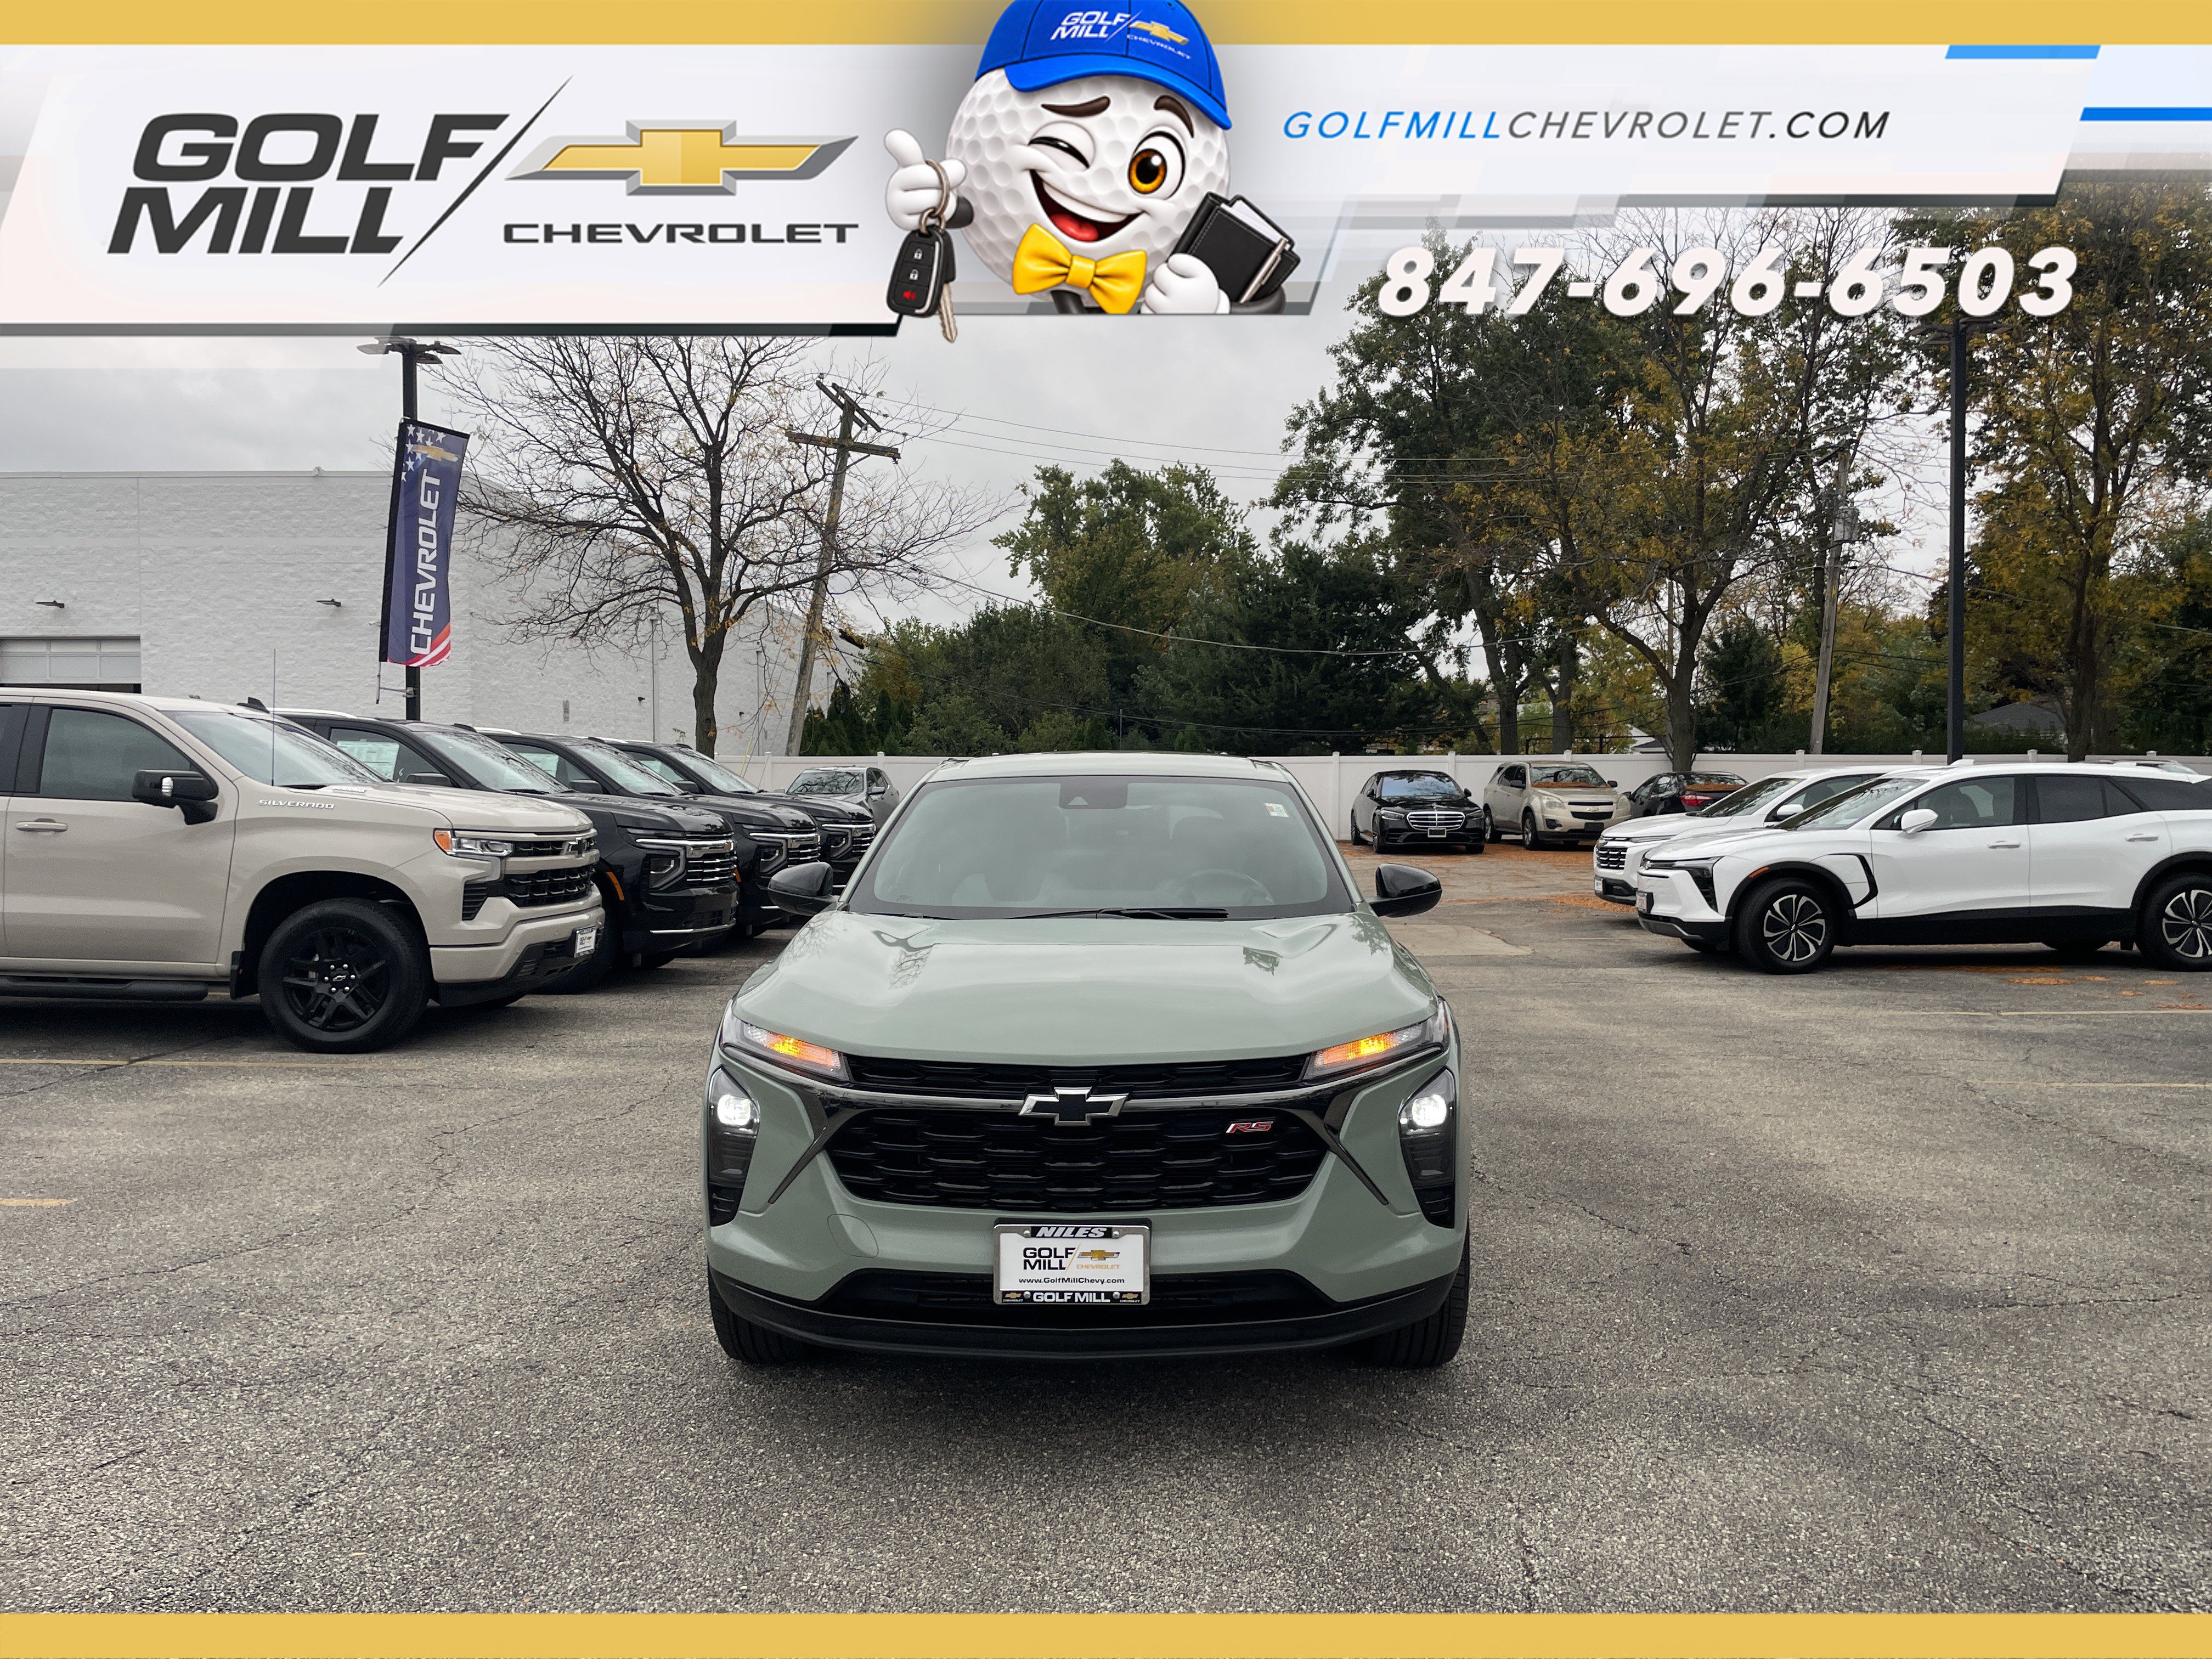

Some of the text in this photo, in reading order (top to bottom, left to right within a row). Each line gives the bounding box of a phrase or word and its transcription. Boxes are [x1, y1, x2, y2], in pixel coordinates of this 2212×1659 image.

[410, 469, 441, 655] CHEVROLET
[258, 799, 335, 809] SILVERADO
[1226, 1121, 1274, 1133] RS
[1036, 1227, 1107, 1238] NILES
[1023, 1247, 1076, 1259] GOLF
[1023, 1259, 1066, 1271] MILL
[1032, 1293, 1111, 1302] GOLF MILL
